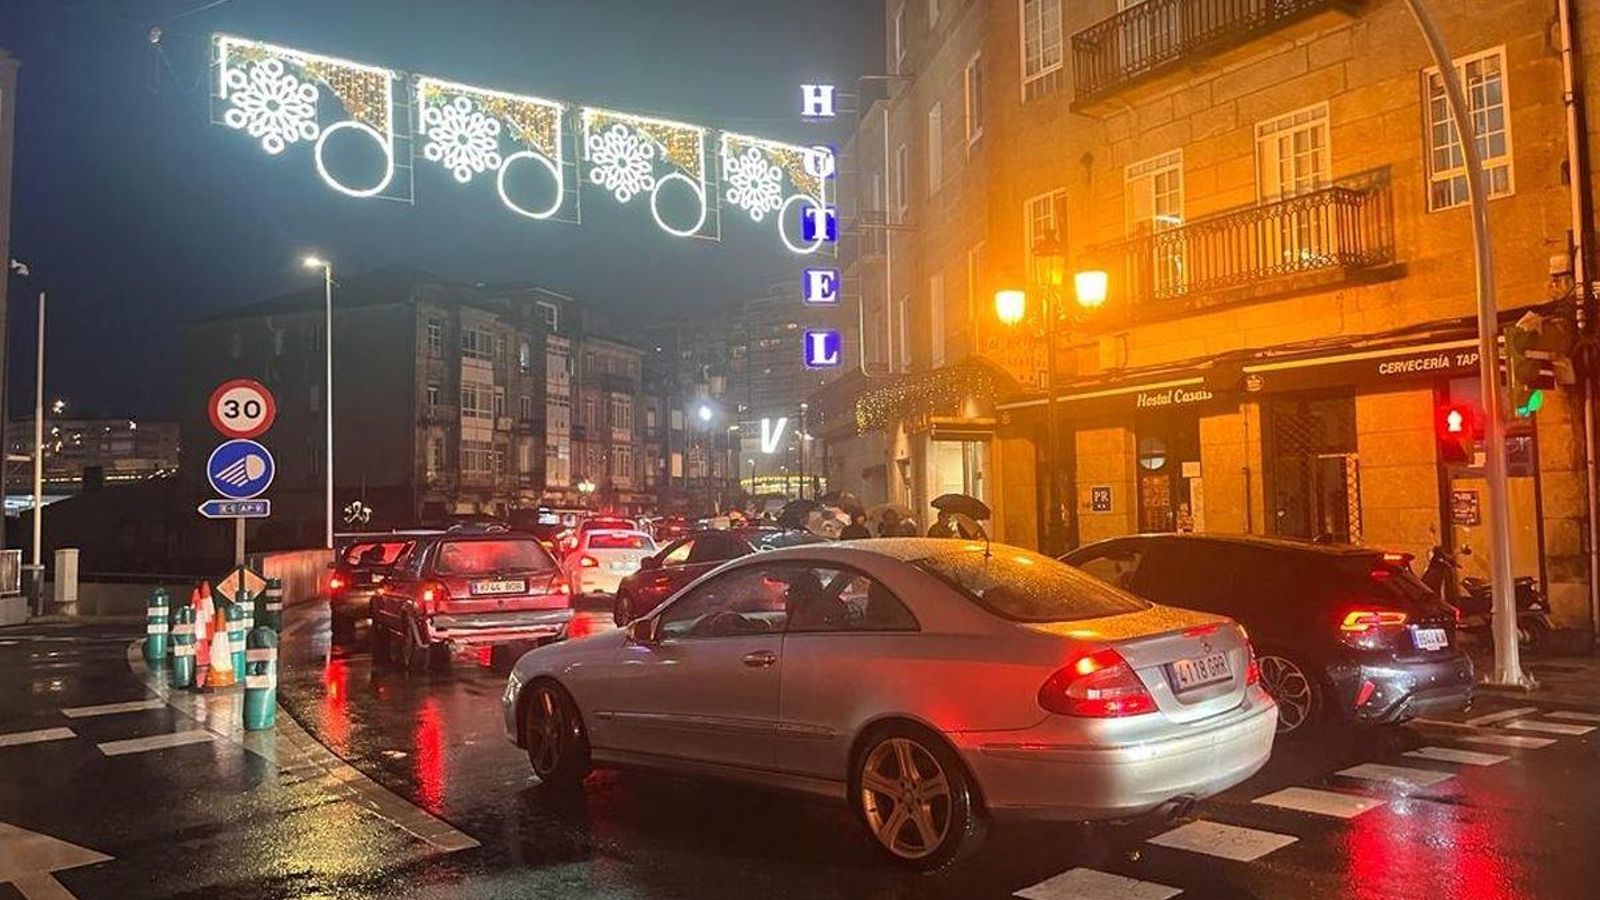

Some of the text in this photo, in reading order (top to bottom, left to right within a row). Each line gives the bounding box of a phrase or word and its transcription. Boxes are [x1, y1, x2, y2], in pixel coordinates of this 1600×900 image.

[800, 84, 837, 364] HOTEL
[1378, 353, 1479, 374] CERVECERÍA TAP
[1136, 390, 1172, 407] Hostal
[223, 400, 261, 419] 30
[1094, 490, 1109, 502] PR
[1179, 660, 1207, 684] 4118
